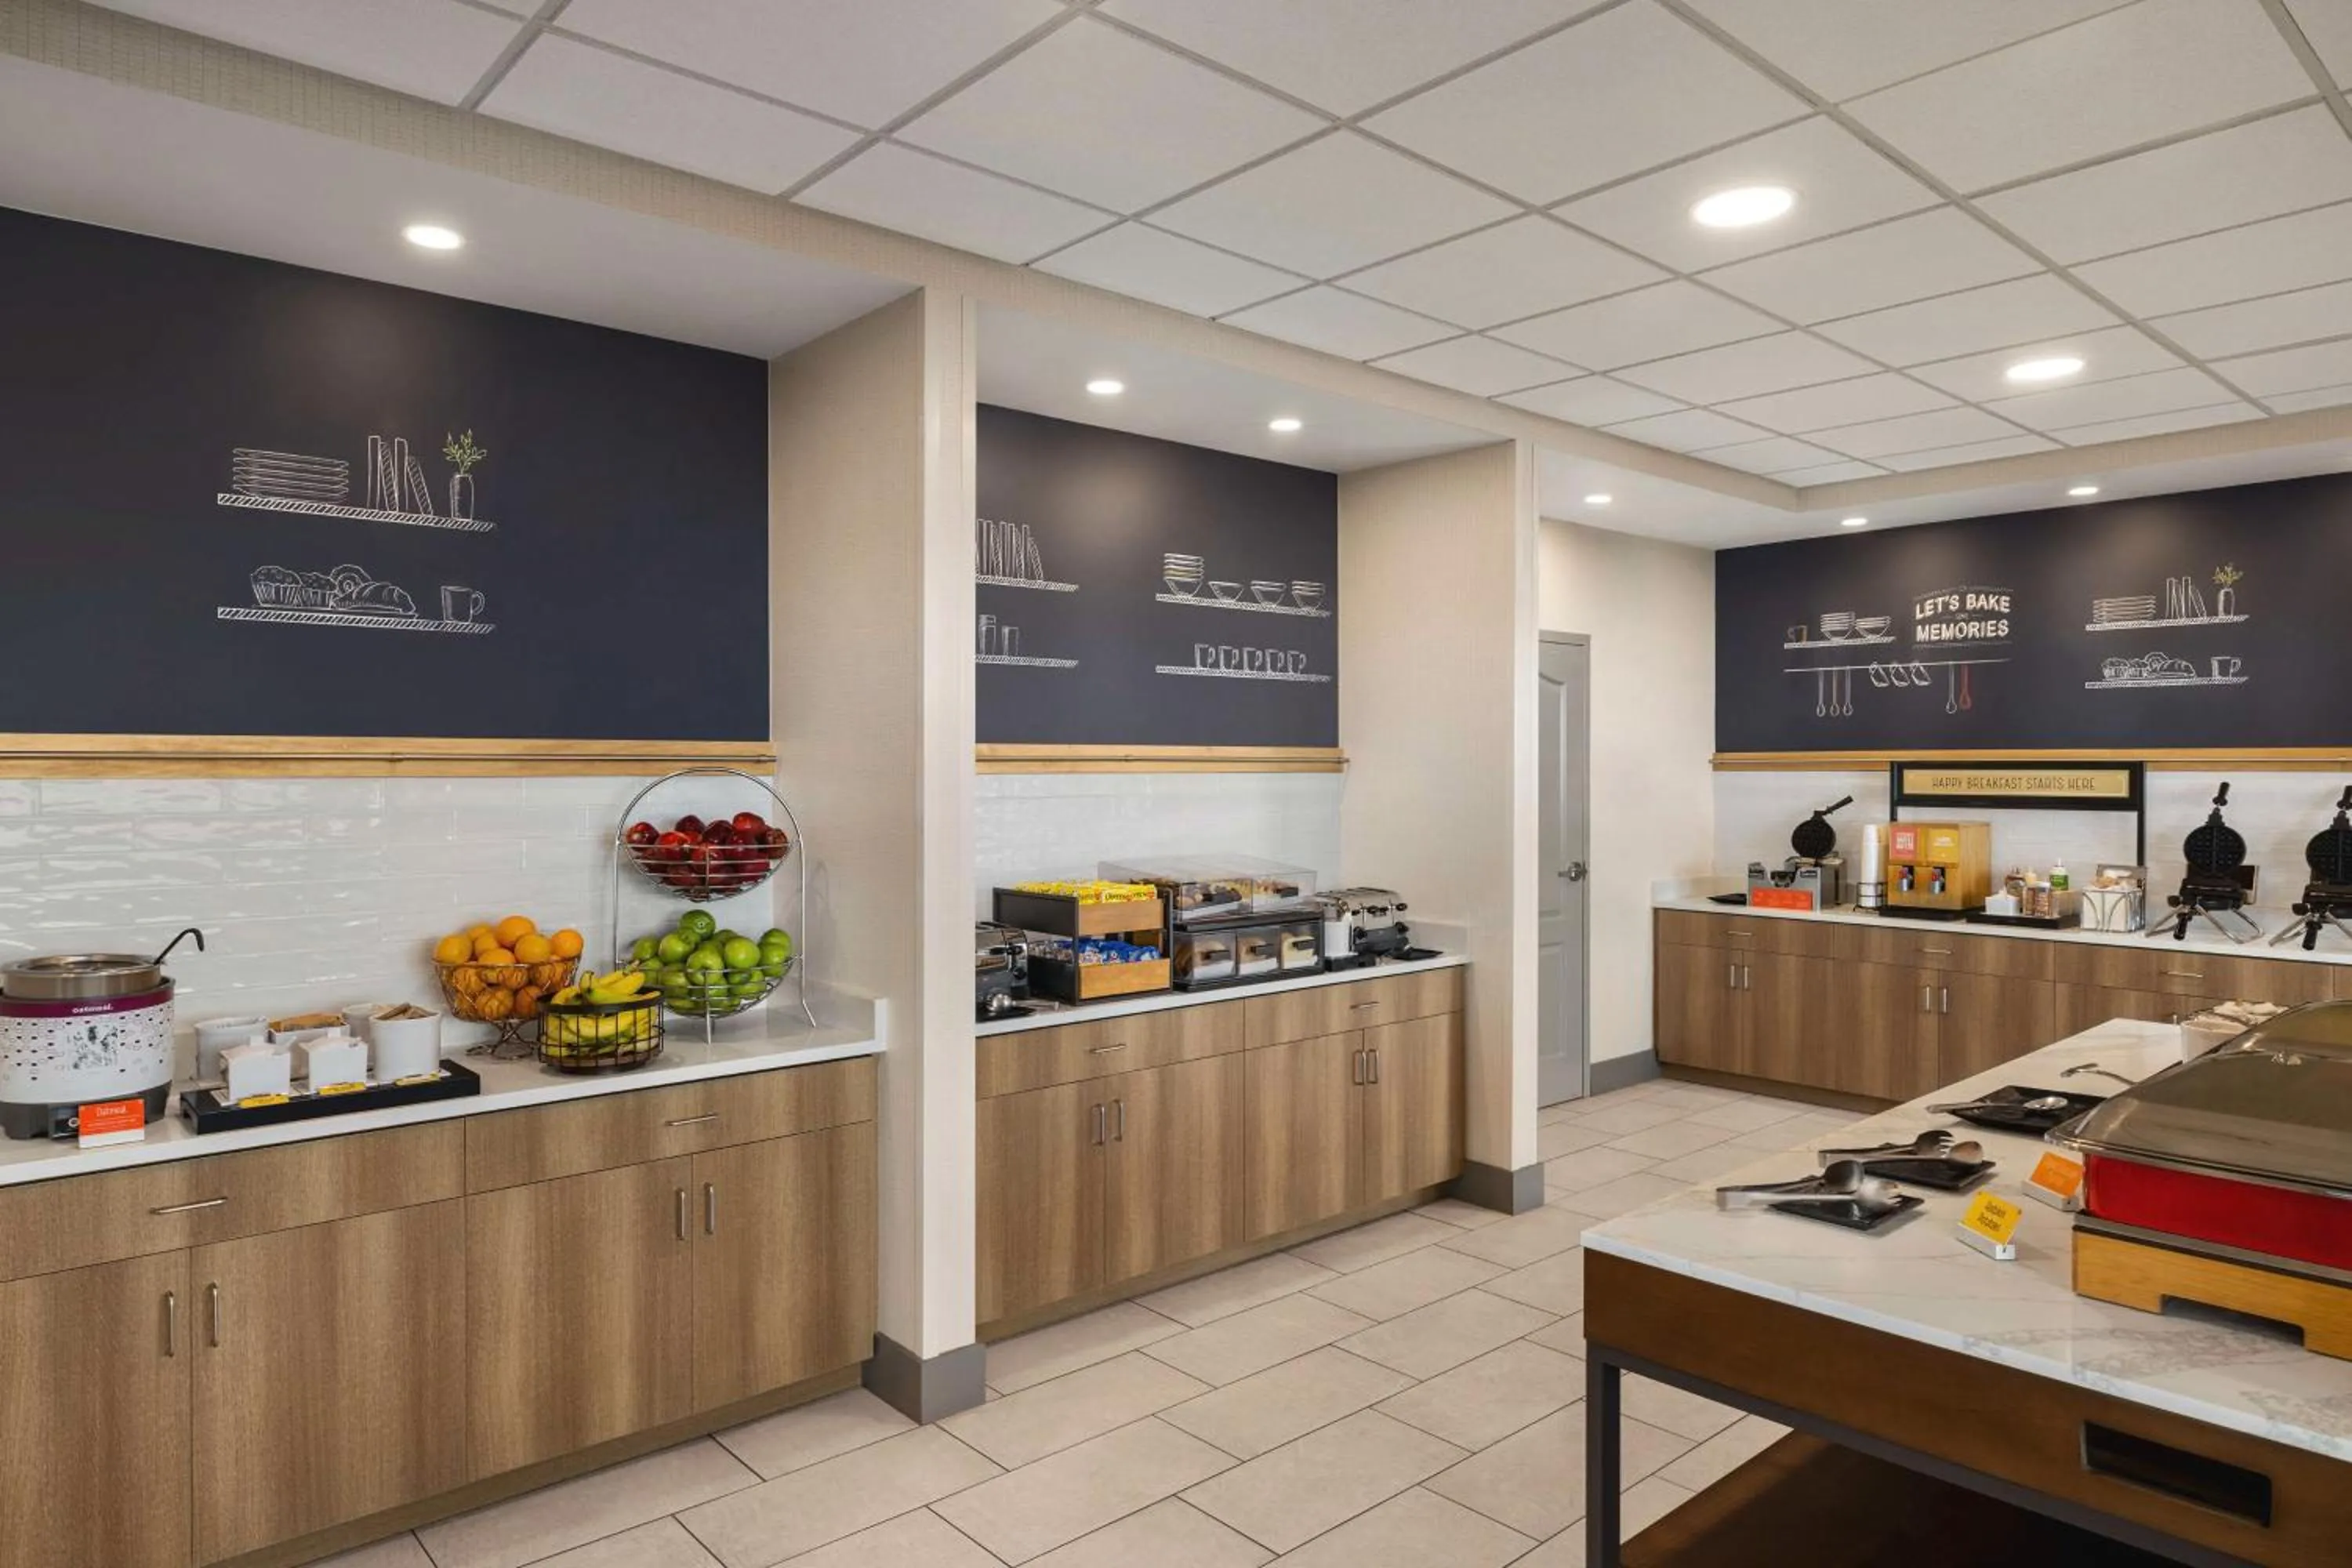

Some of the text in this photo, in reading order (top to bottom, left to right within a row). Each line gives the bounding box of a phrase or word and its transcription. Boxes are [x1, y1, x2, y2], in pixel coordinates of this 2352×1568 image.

[1915, 593, 2011, 620] LET'S BAKE
[1916, 619, 2009, 641] MEMORIES
[1932, 776, 2095, 791] HAPPY BREAKFAST STARTS HERE
